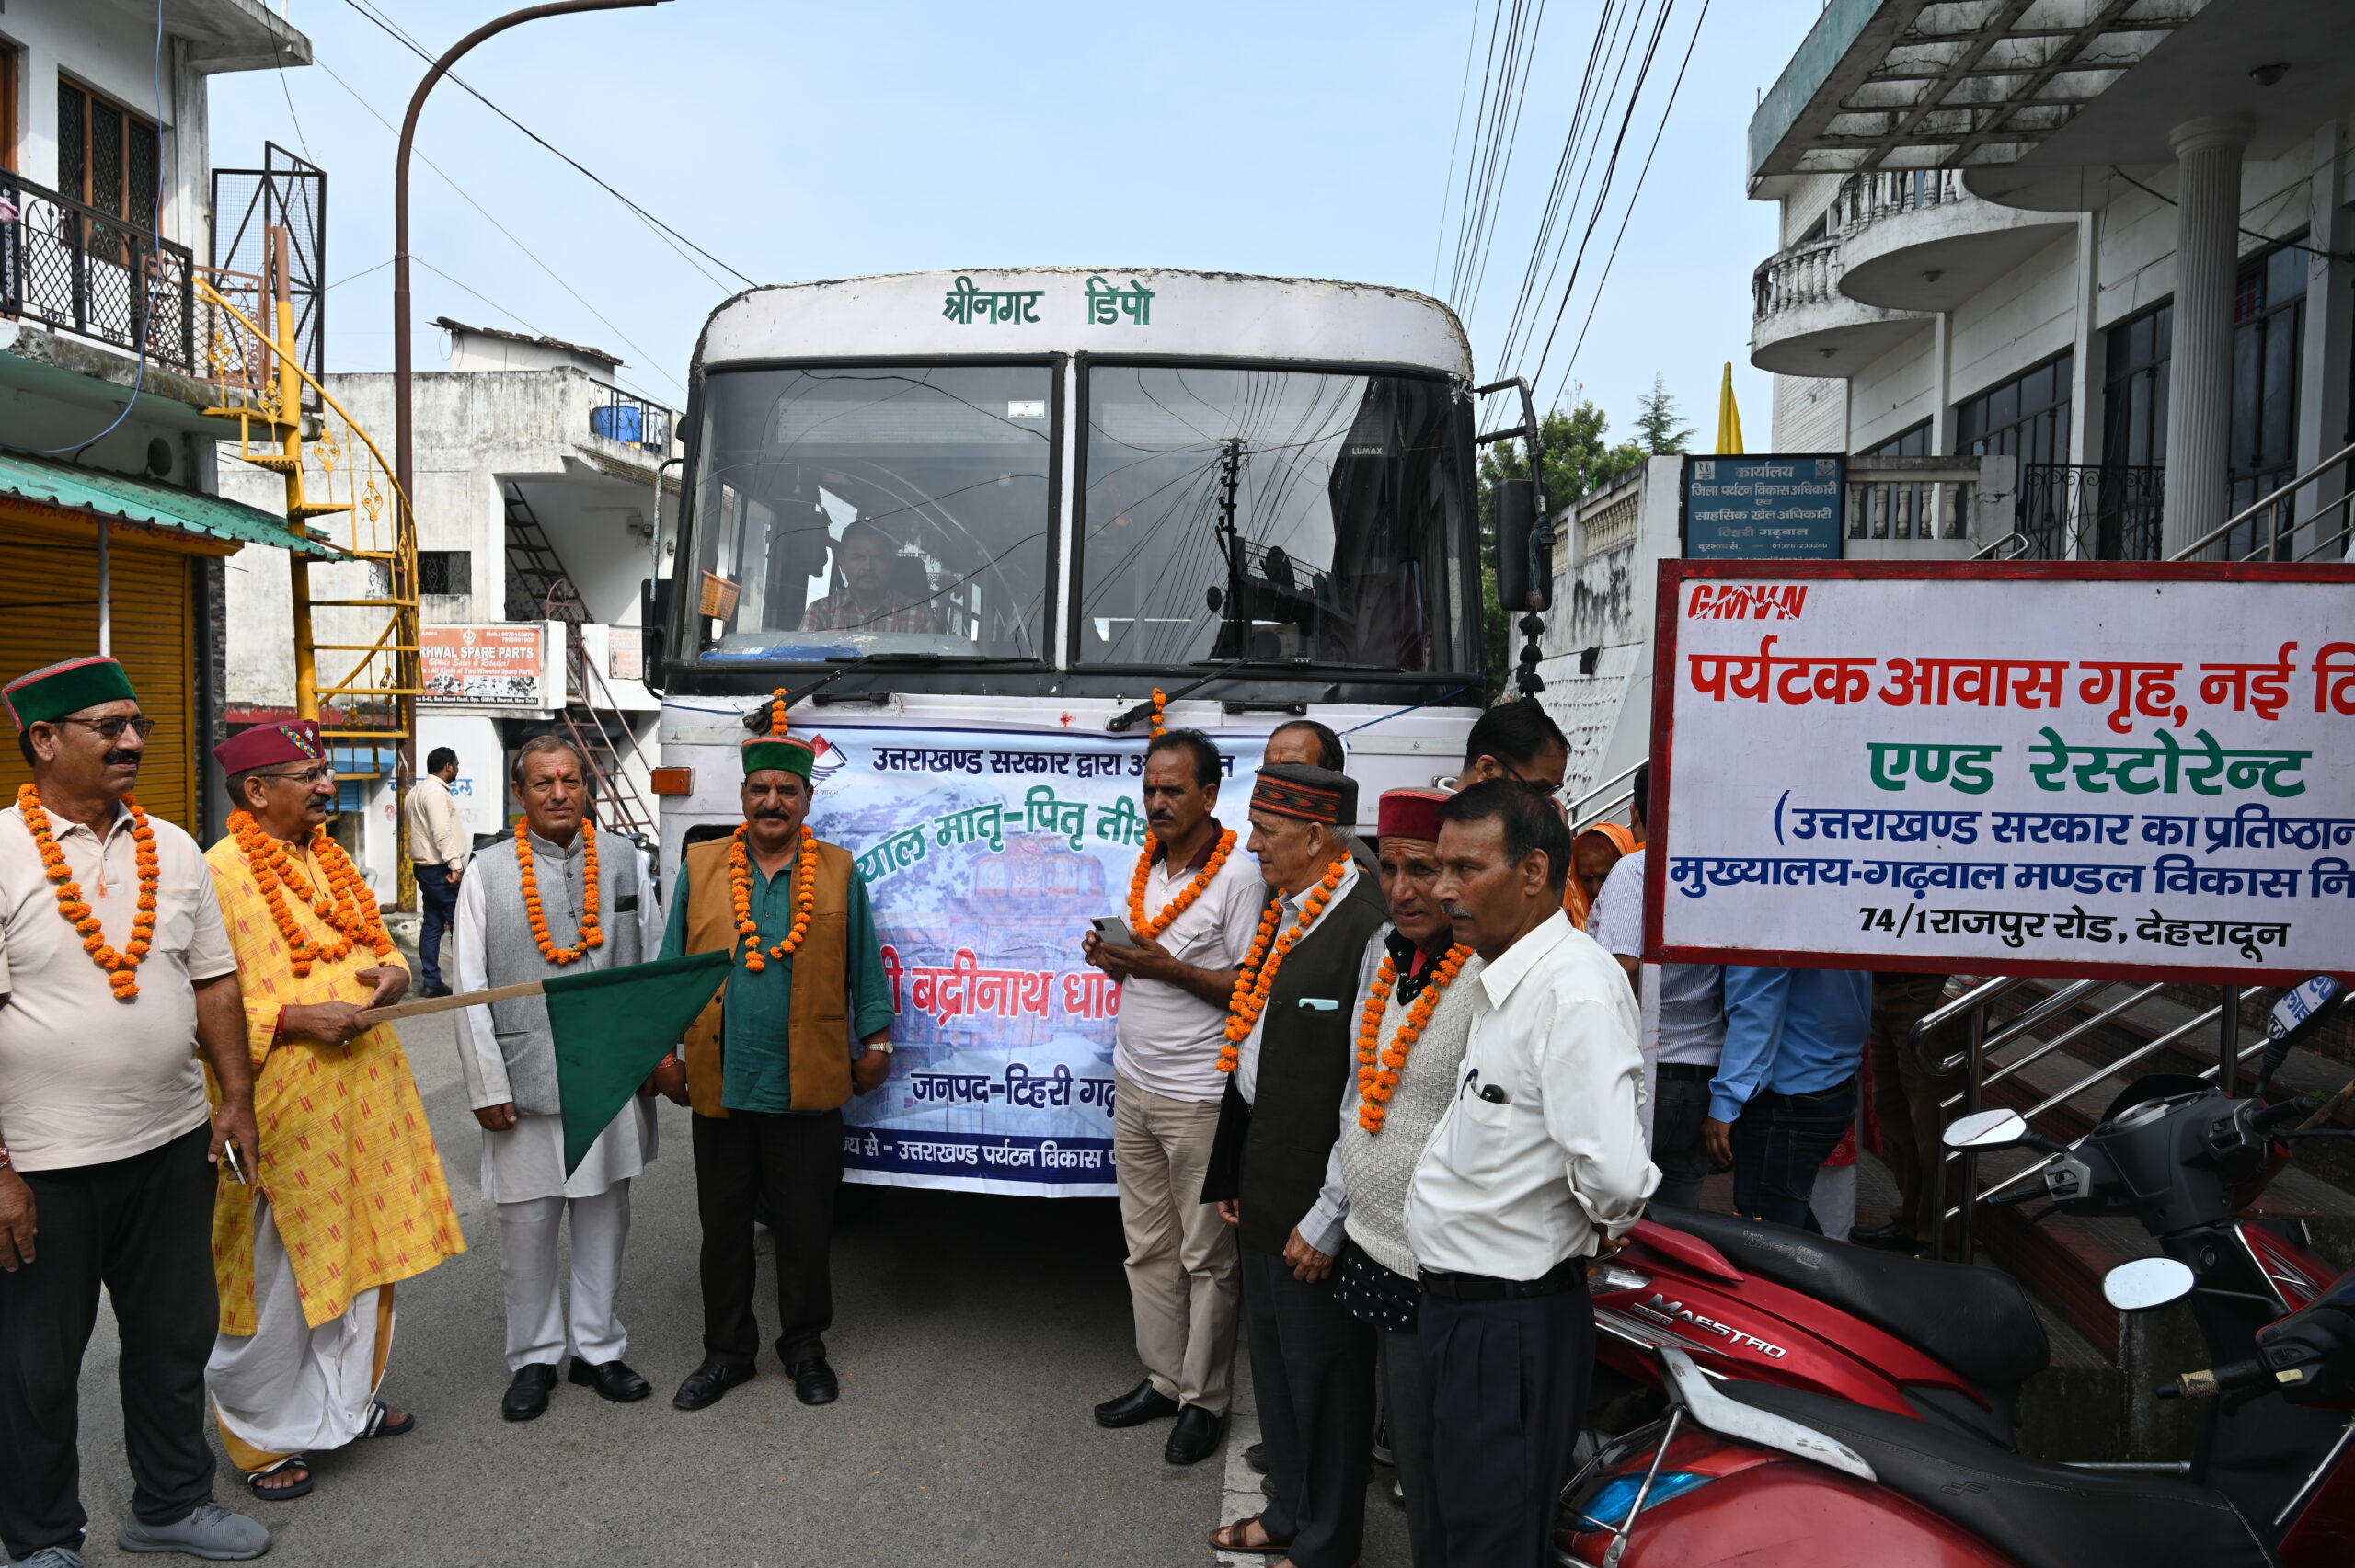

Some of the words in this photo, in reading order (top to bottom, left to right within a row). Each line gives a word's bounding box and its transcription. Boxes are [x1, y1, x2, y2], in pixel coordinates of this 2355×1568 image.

[942, 276, 1045, 325] श्रीनगर
[1085, 276, 1155, 325] डिपो
[1351, 447, 1383, 455] LUMAX
[1735, 462, 1794, 478] कार्यालय
[1692, 483, 1718, 497] जिला
[1721, 482, 1752, 497] पर्यटन
[1755, 481, 1790, 496] विकास
[1791, 481, 1837, 496] अधिकारी
[1694, 509, 1747, 521] साहसिक
[1751, 508, 1776, 521] खेल
[1777, 508, 1832, 520] अधिकारी
[1759, 528, 1809, 539] गढ़वाल
[1688, 585, 1808, 620] GMVN
[419, 646, 457, 658] RHWAL
[461, 647, 495, 658] SPARE
[499, 647, 534, 659] PARTS
[1688, 635, 1876, 705] पर्यटक
[1878, 658, 2070, 709] आवास
[2079, 661, 2188, 734] गृह,
[2200, 642, 2298, 721] नई
[872, 746, 982, 774] उत्तराखण्ड
[989, 750, 1071, 775] सरकार
[1074, 752, 1122, 778] द्वारा
[1868, 743, 2002, 795] एण्ड
[2029, 727, 2312, 797] रेस्टोरेन्ट
[1774, 790, 1982, 845] (उत्तराखण्ड
[1992, 812, 2131, 845] सरकार
[2142, 816, 2199, 847] का
[2014, 864, 2146, 894] मण्डल
[2153, 853, 2302, 898] विकास
[2053, 905, 2127, 944] रोड,
[2135, 908, 2292, 964] देहरादून
[912, 948, 1053, 1026] बद्रीनाथ
[864, 1131, 879, 1156] से
[897, 1140, 979, 1165] उत्तराखण्ड
[982, 1139, 1036, 1167] पर्यटन
[1040, 1140, 1103, 1168] विकास
[1646, 1292, 1788, 1359] MAESTRO
